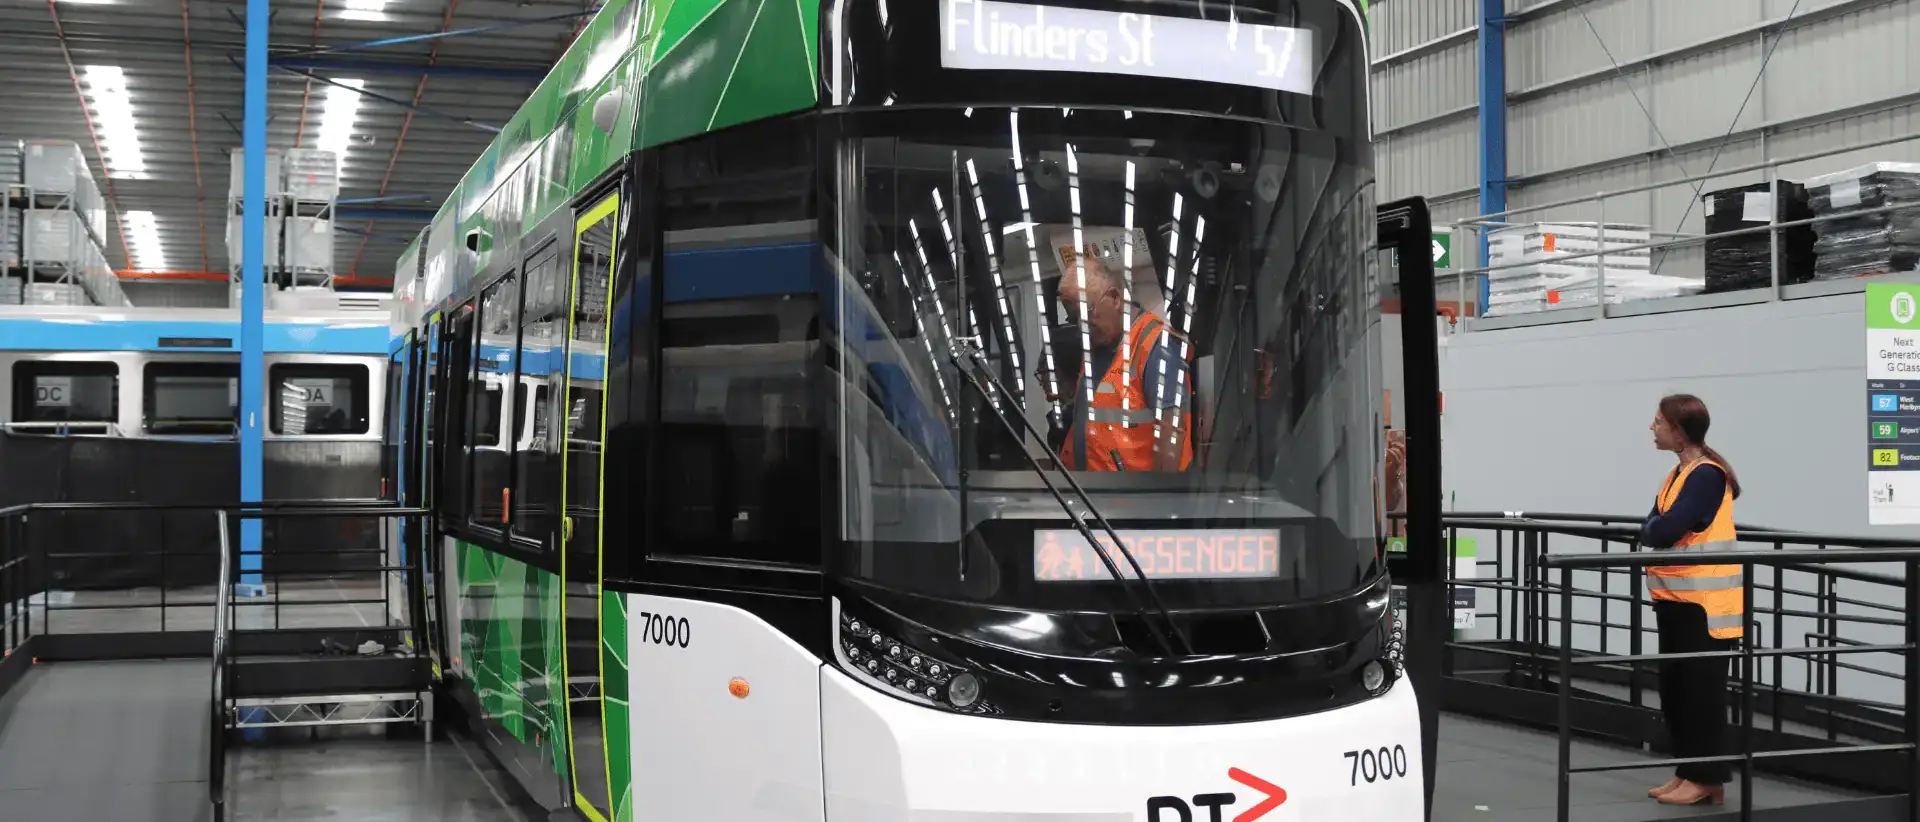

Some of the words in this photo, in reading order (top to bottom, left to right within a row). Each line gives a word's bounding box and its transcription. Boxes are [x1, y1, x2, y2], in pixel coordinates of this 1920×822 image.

[947, 0, 1108, 63] Flinders
[1118, 12, 1154, 67] St
[1254, 24, 1295, 79] 57
[1894, 337, 1915, 347] Next
[1887, 362, 1895, 372] G
[1896, 362, 1920, 372] Class
[1879, 398, 1891, 408] 57
[1879, 424, 1892, 435] 59
[1880, 452, 1891, 462] 82
[1093, 536, 1278, 574] PASSENGER
[1464, 612, 1471, 623] 7
[640, 611, 691, 649] 7000
[1343, 743, 1407, 787] 7000
